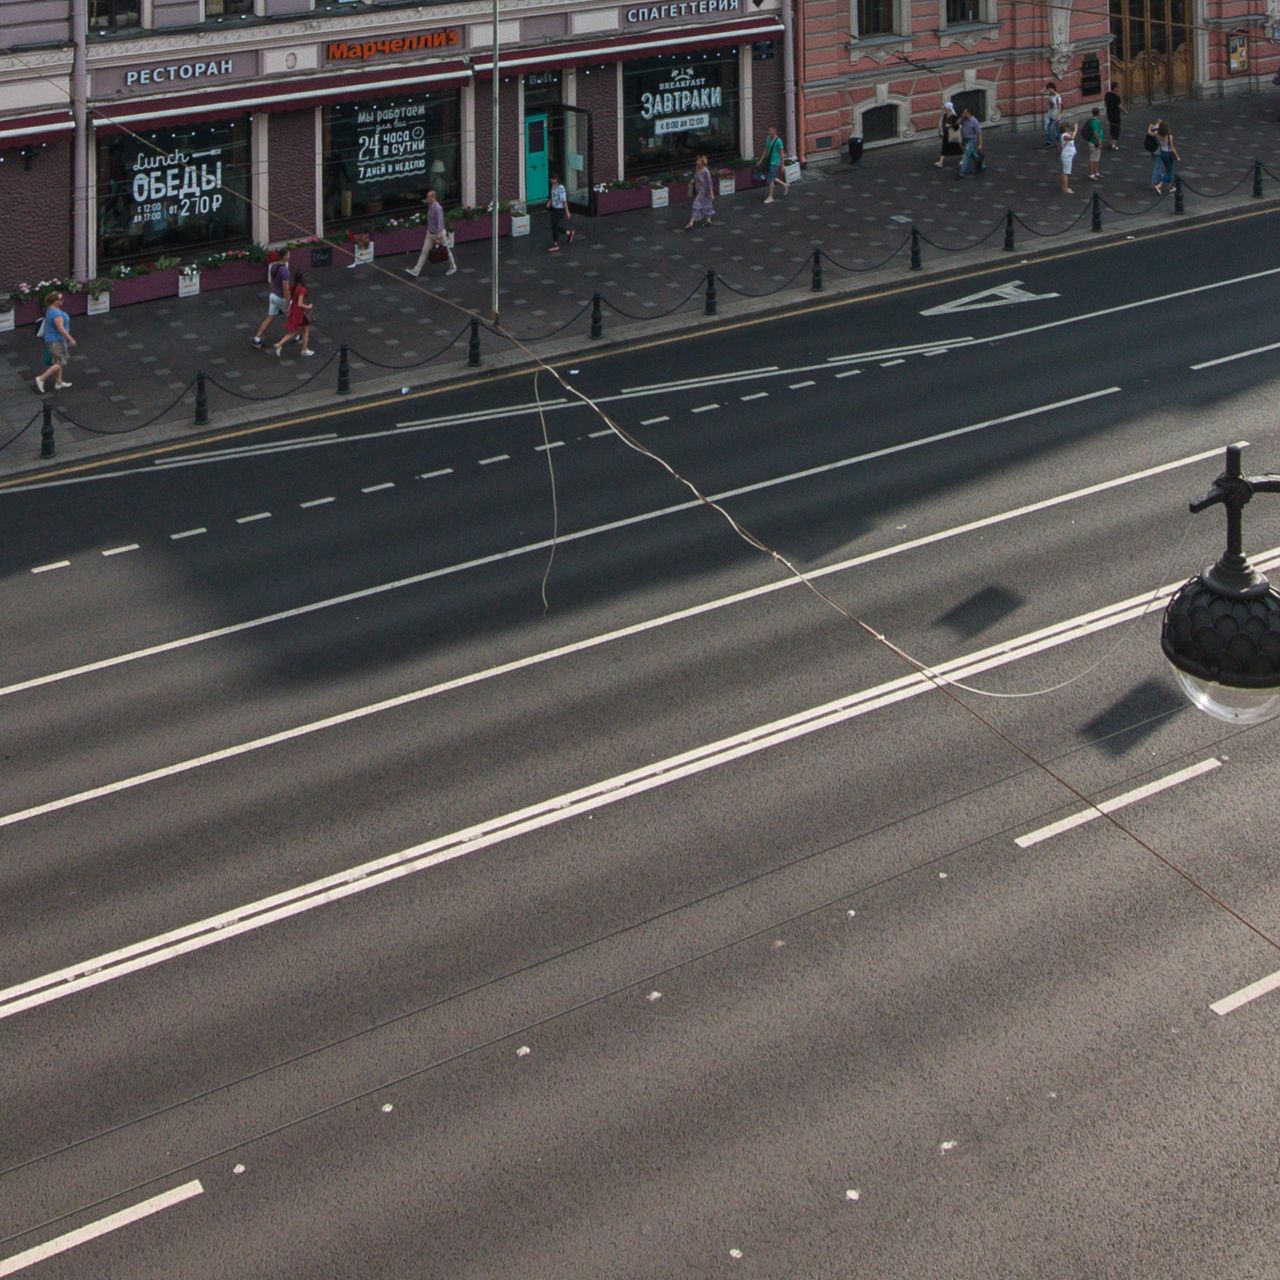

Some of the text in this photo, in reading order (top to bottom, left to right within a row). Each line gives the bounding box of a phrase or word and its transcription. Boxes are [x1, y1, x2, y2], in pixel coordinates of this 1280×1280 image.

[126, 59, 233, 86] РЕСТОРАН
[659, 78, 706, 90] BREAKFAST
[641, 86, 722, 120] ЗАВТРАКИ
[358, 105, 426, 123] Мы работаем
[358, 134, 380, 160] 24
[133, 148, 189, 171] Lunch
[133, 161, 222, 202] ОБЕДЫ
[359, 167, 364, 178] 7
[143, 202, 161, 211] 12:00
[144, 212, 161, 221] 17:00
